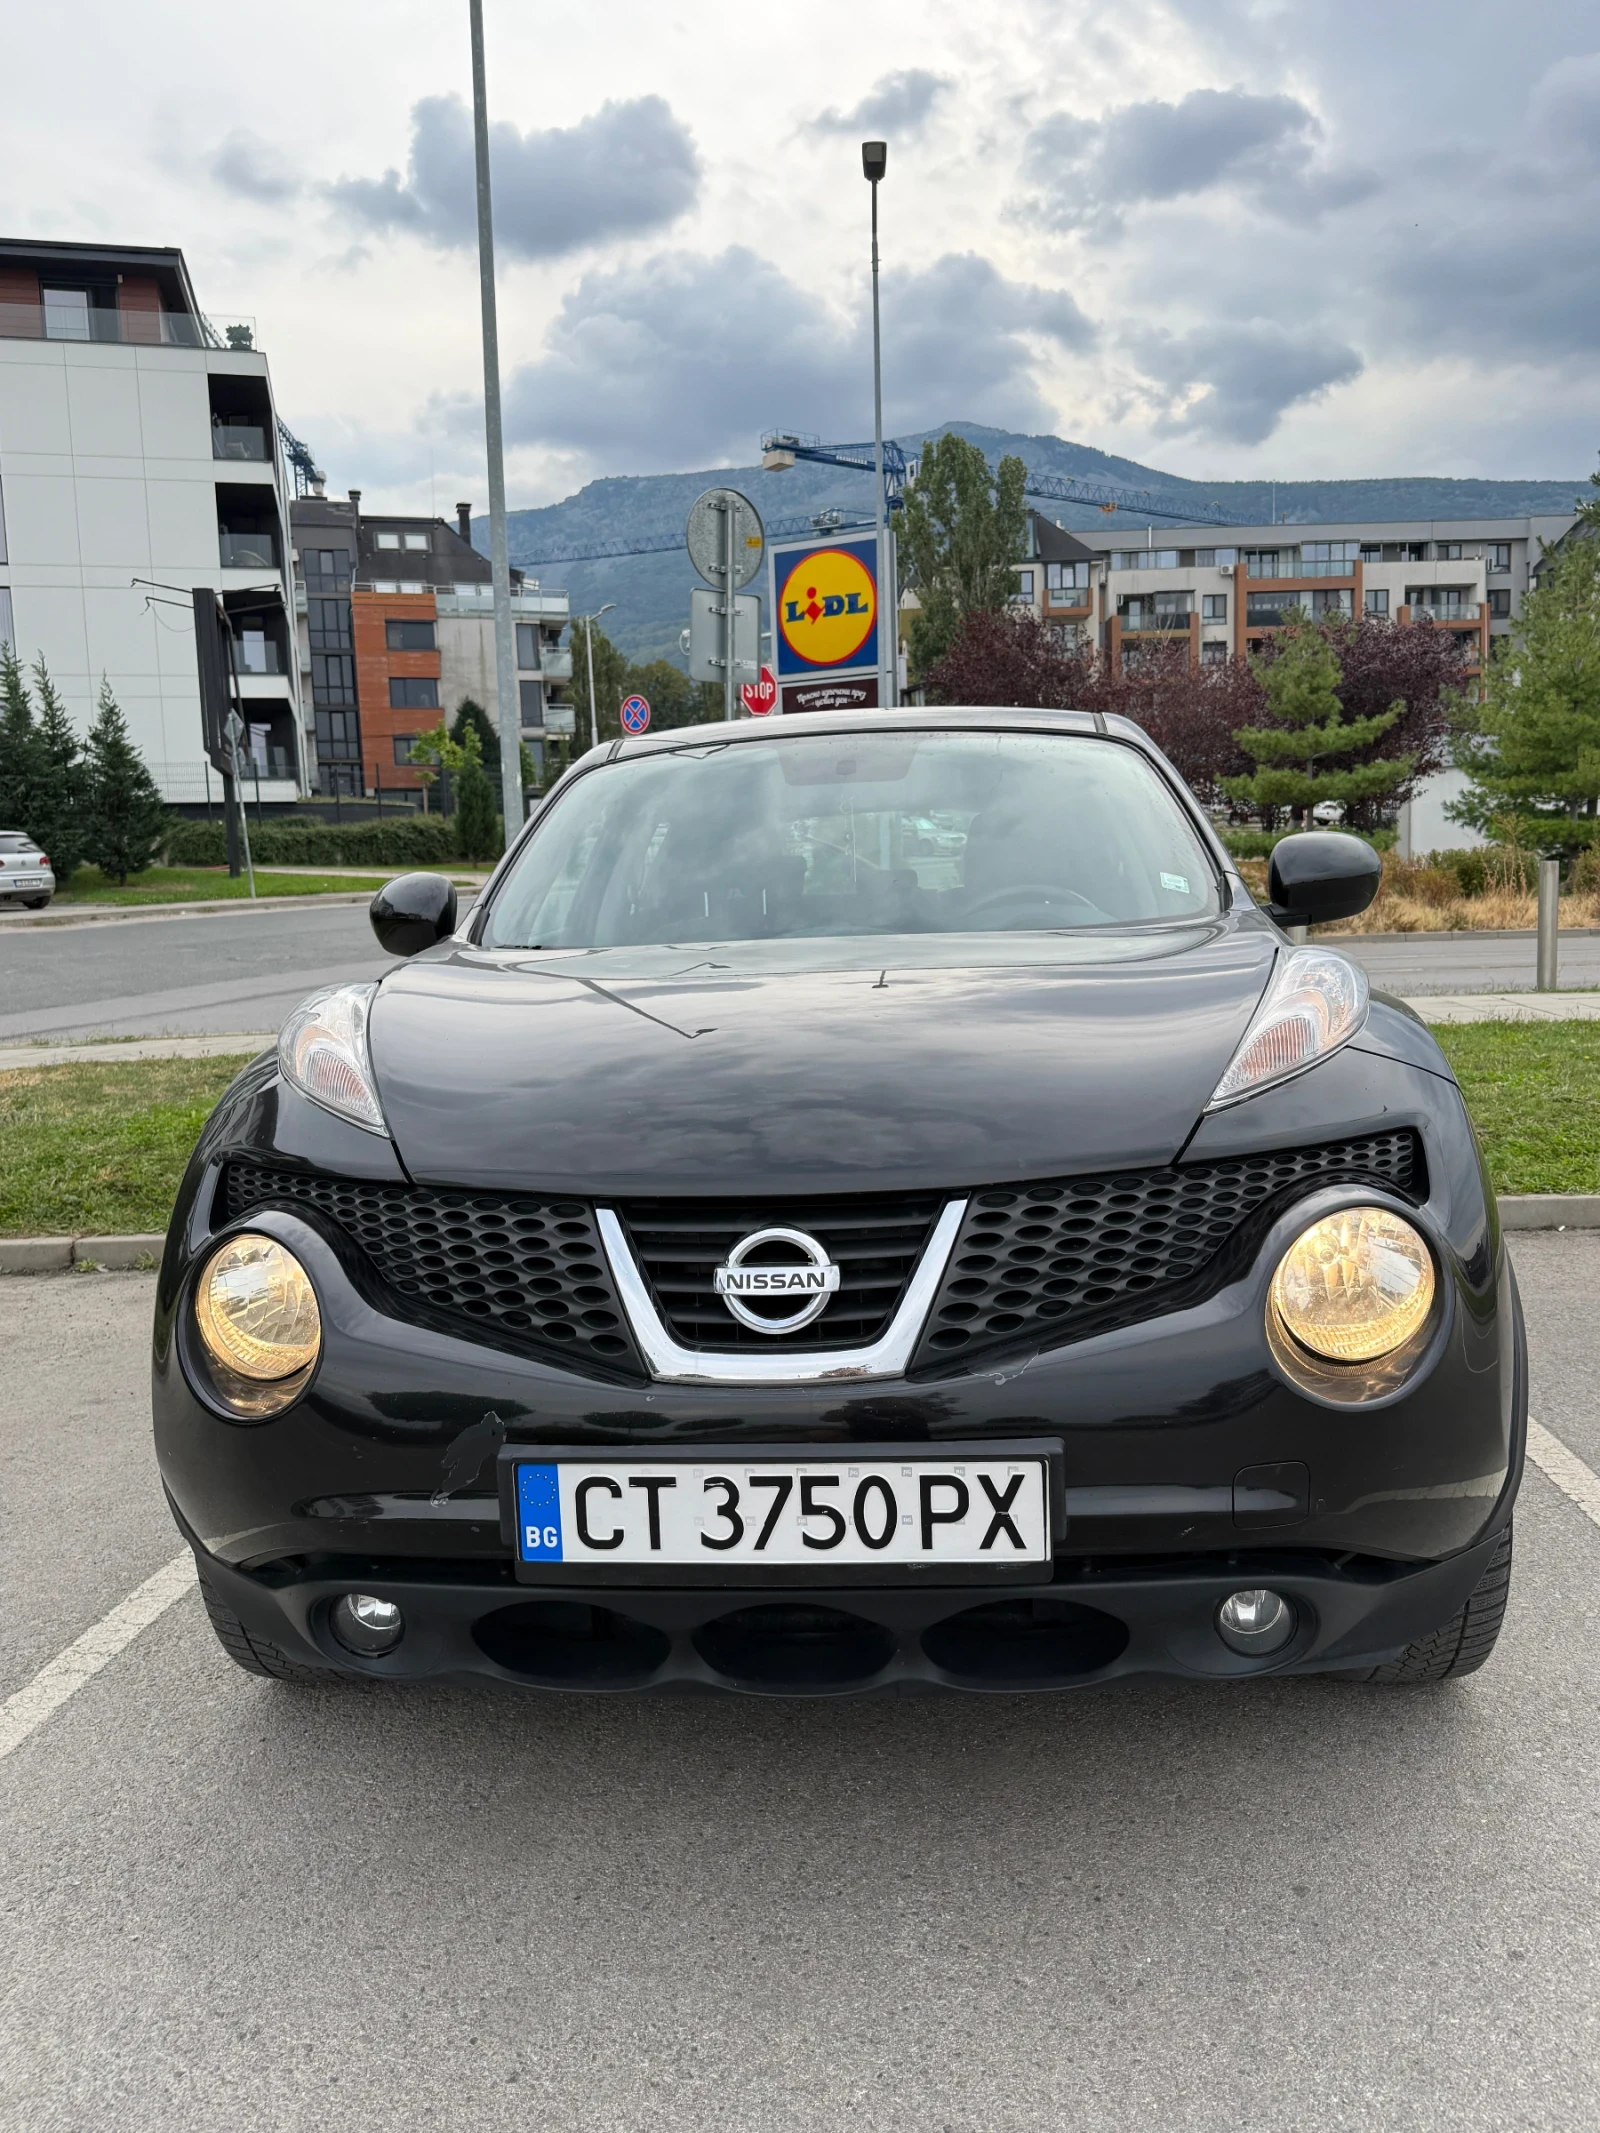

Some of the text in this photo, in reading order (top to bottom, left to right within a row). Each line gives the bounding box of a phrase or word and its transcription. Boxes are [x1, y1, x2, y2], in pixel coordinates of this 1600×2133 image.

[726, 1272, 825, 1289] NISSAN
[575, 1474, 1027, 1550] CT 3750 PX
[525, 1526, 558, 1548] BG
